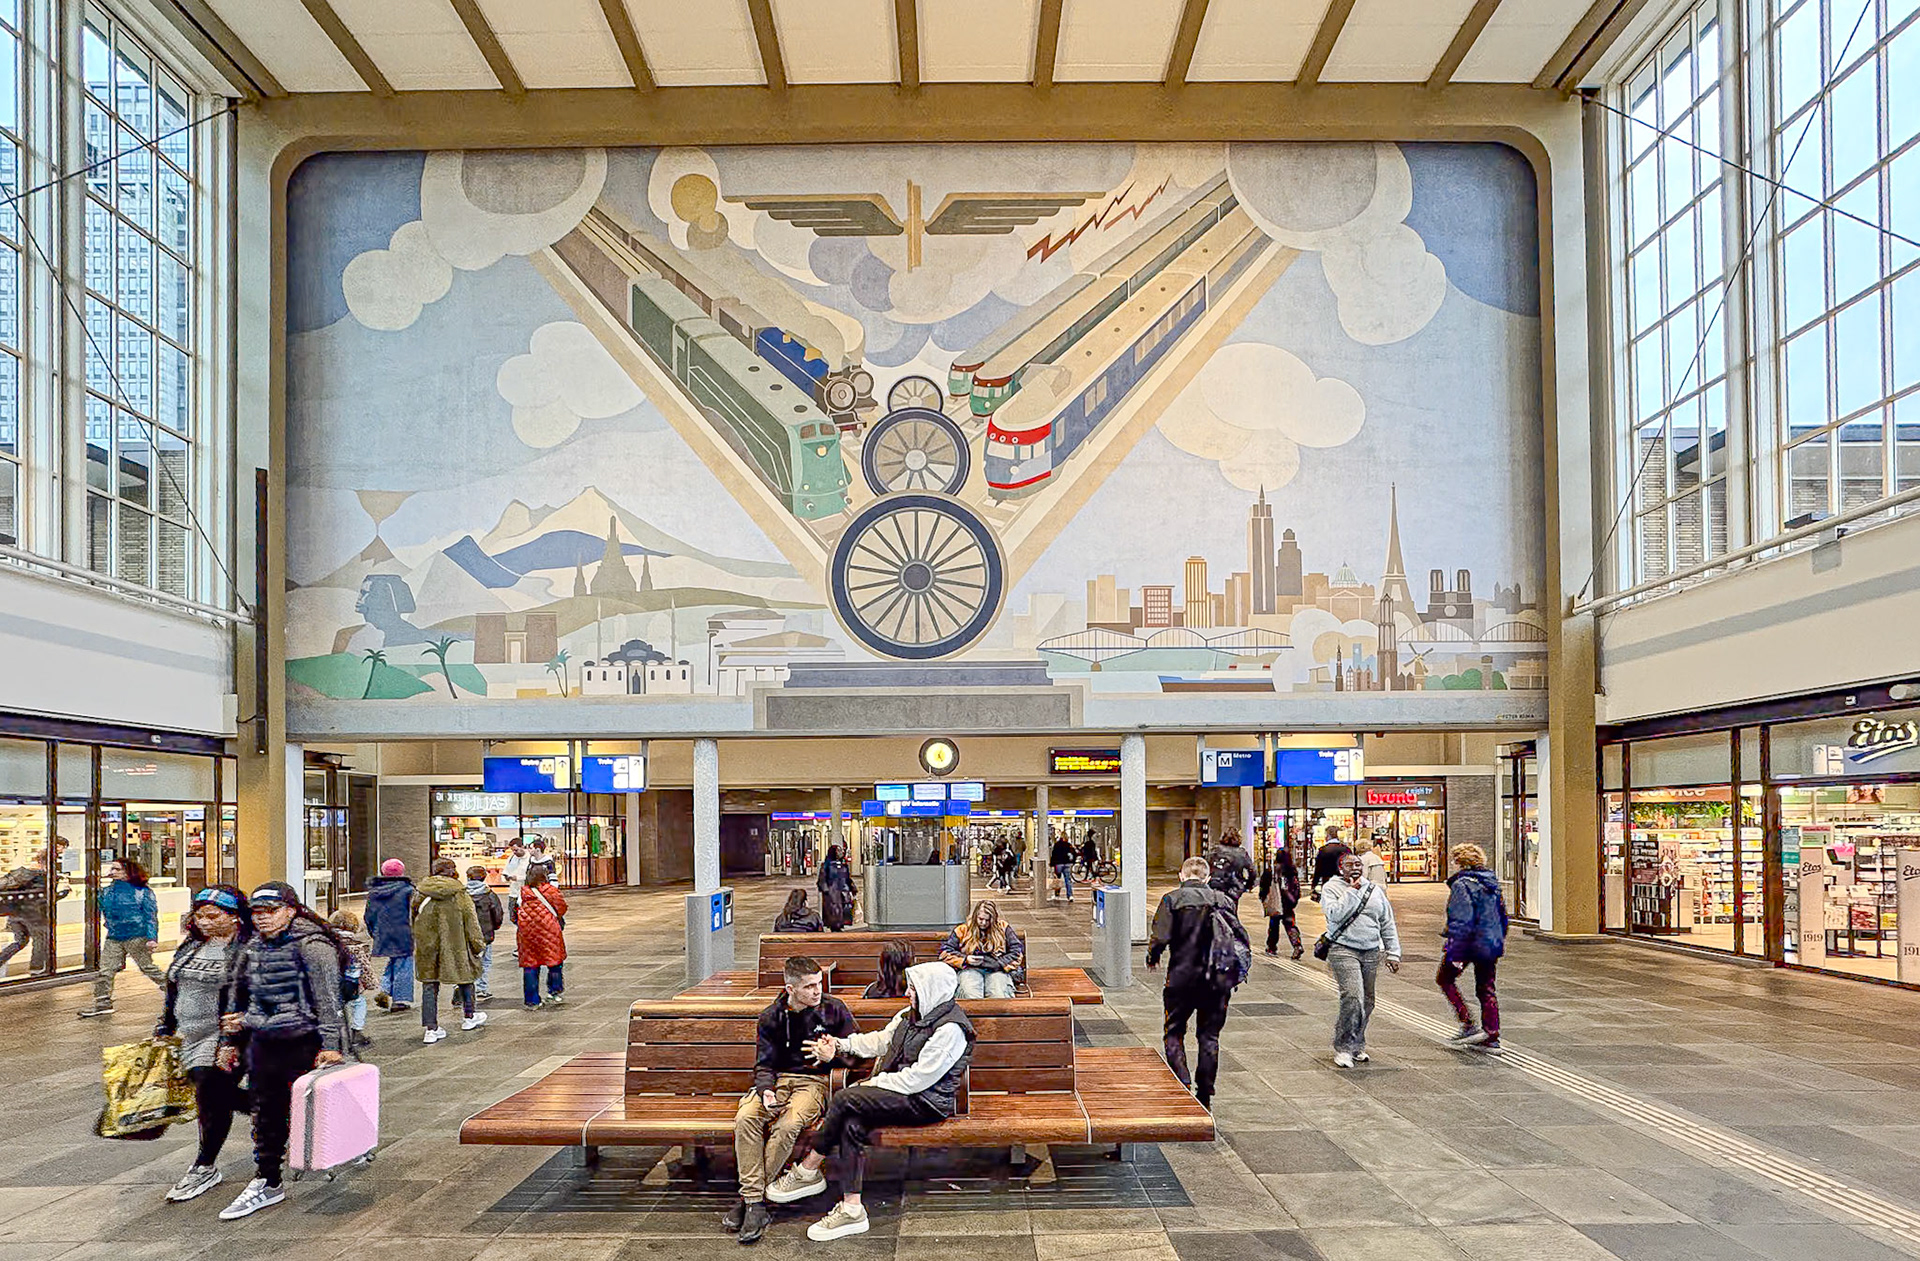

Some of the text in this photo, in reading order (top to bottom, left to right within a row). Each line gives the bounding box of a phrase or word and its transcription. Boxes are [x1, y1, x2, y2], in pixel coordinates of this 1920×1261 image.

[1848, 717, 1918, 748] Etos
[1220, 757, 1230, 766] M
[1367, 788, 1418, 805] bruna
[1803, 933, 1823, 943] 1919
[1904, 946, 1920, 956] 191
